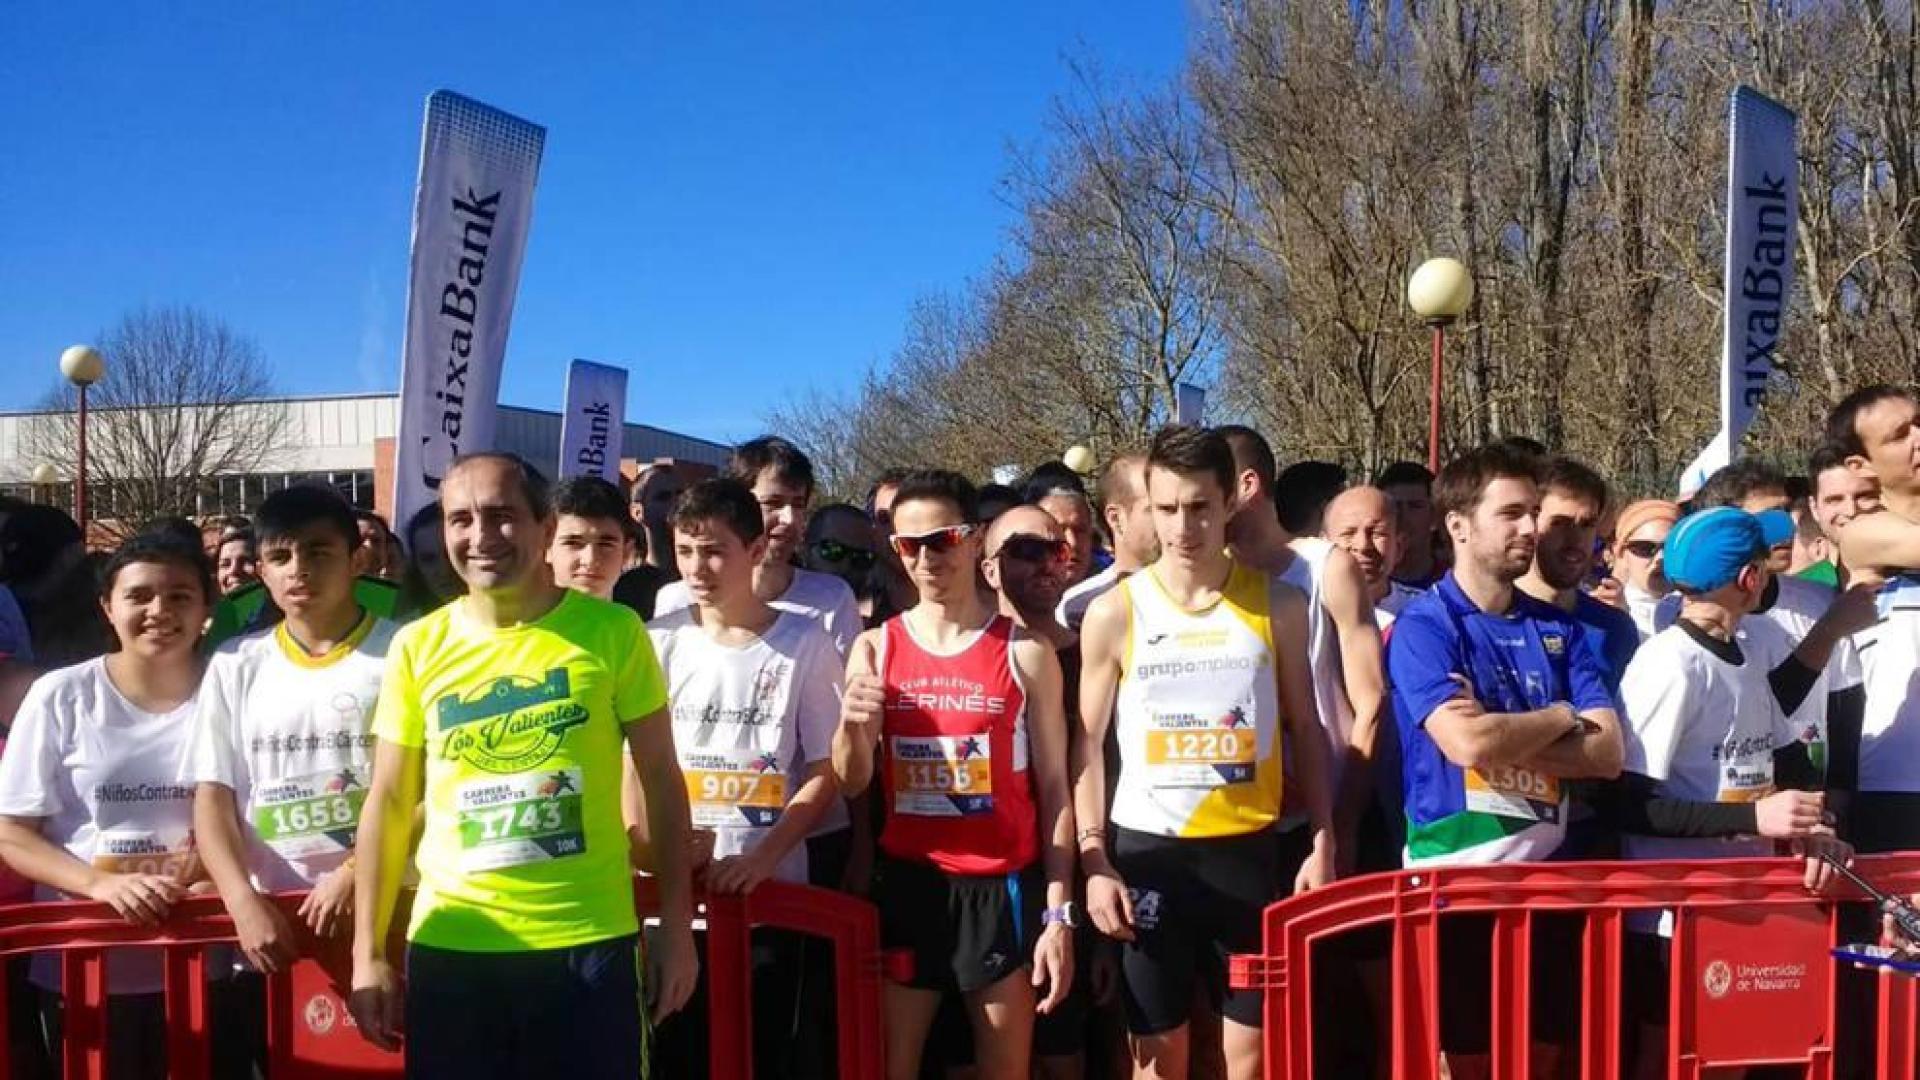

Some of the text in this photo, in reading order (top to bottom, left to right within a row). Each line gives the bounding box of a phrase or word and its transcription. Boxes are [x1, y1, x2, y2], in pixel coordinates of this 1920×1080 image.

[1165, 733, 1238, 760] 1220
[703, 774, 760, 801] 907
[272, 798, 352, 833] 1658
[481, 801, 562, 839] 1743
[1737, 963, 1807, 976] Universidad
[1736, 977, 1801, 991] de Navarra
